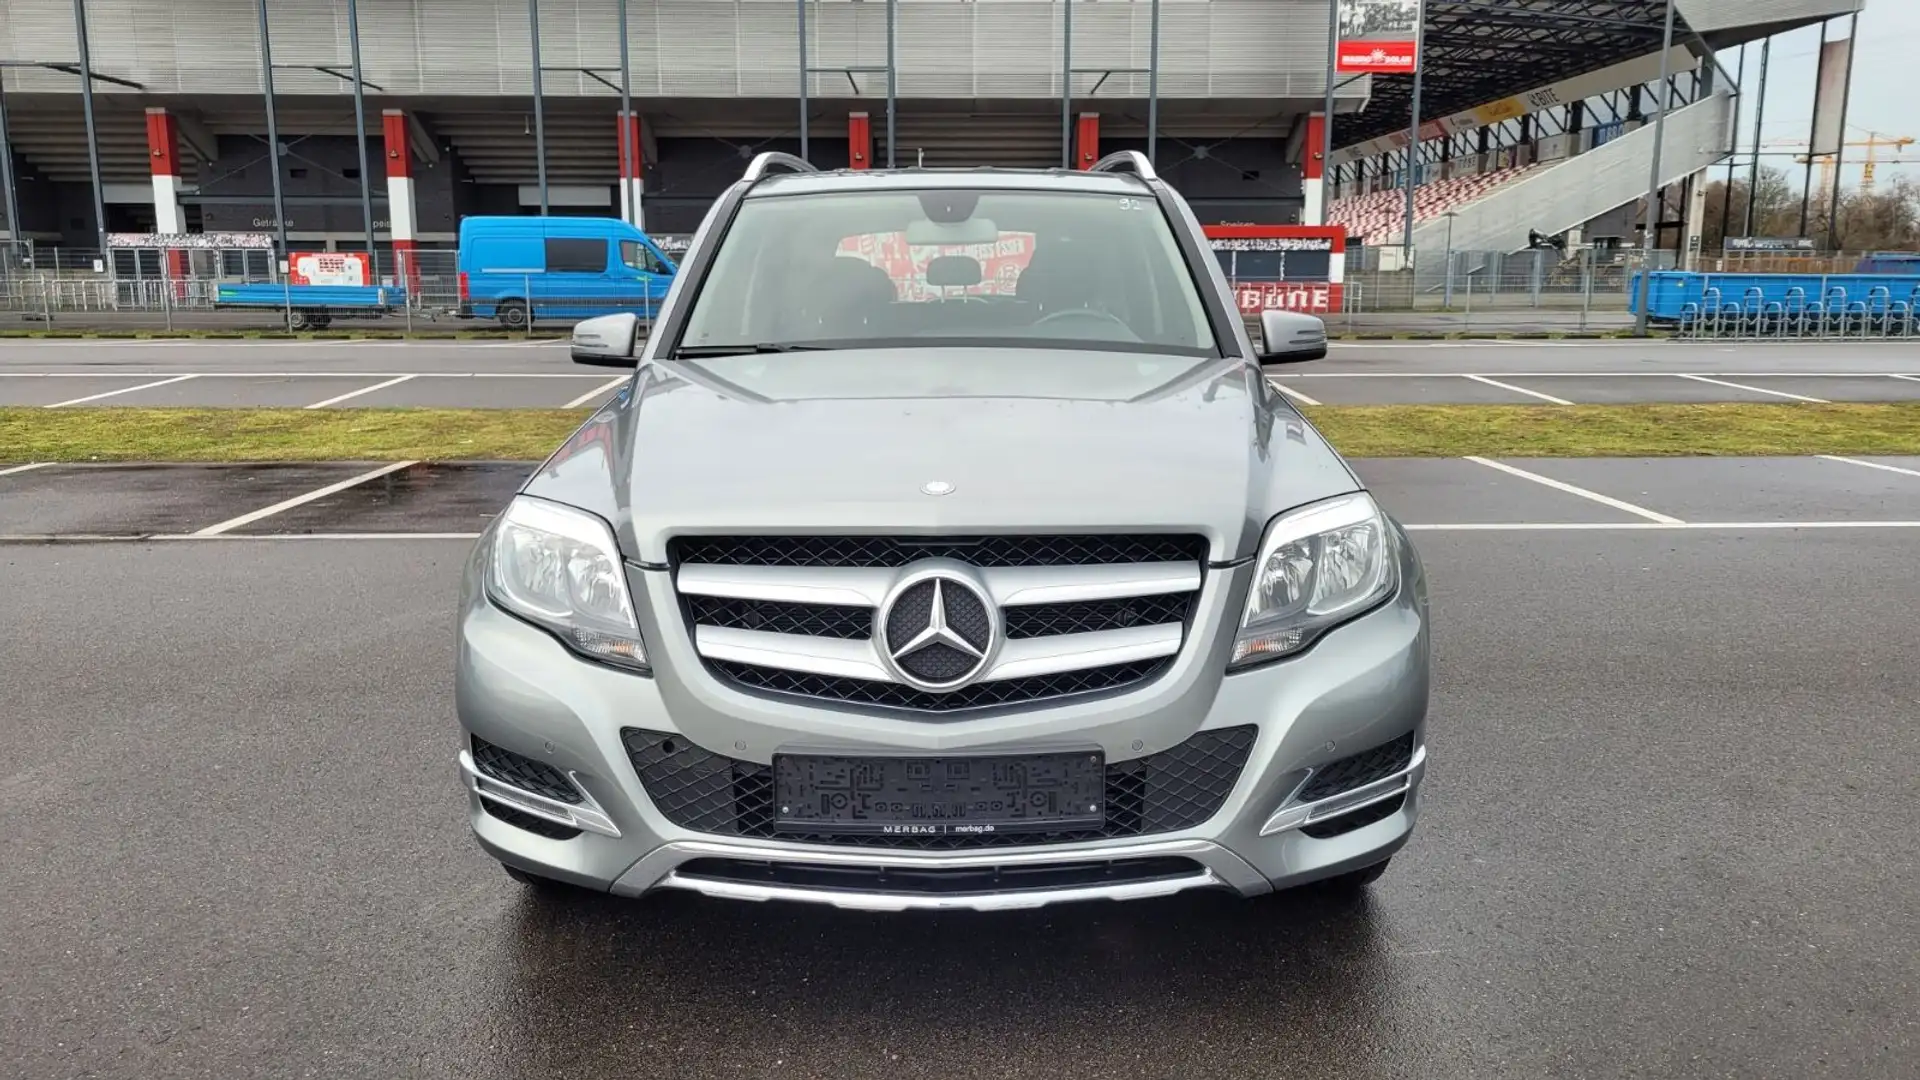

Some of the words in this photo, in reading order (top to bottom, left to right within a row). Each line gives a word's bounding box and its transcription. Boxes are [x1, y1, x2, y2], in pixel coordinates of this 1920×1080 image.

[252, 218, 294, 227] Geträke
[883, 825, 936, 833] MERBAG
[955, 824, 995, 834] merbag.de
